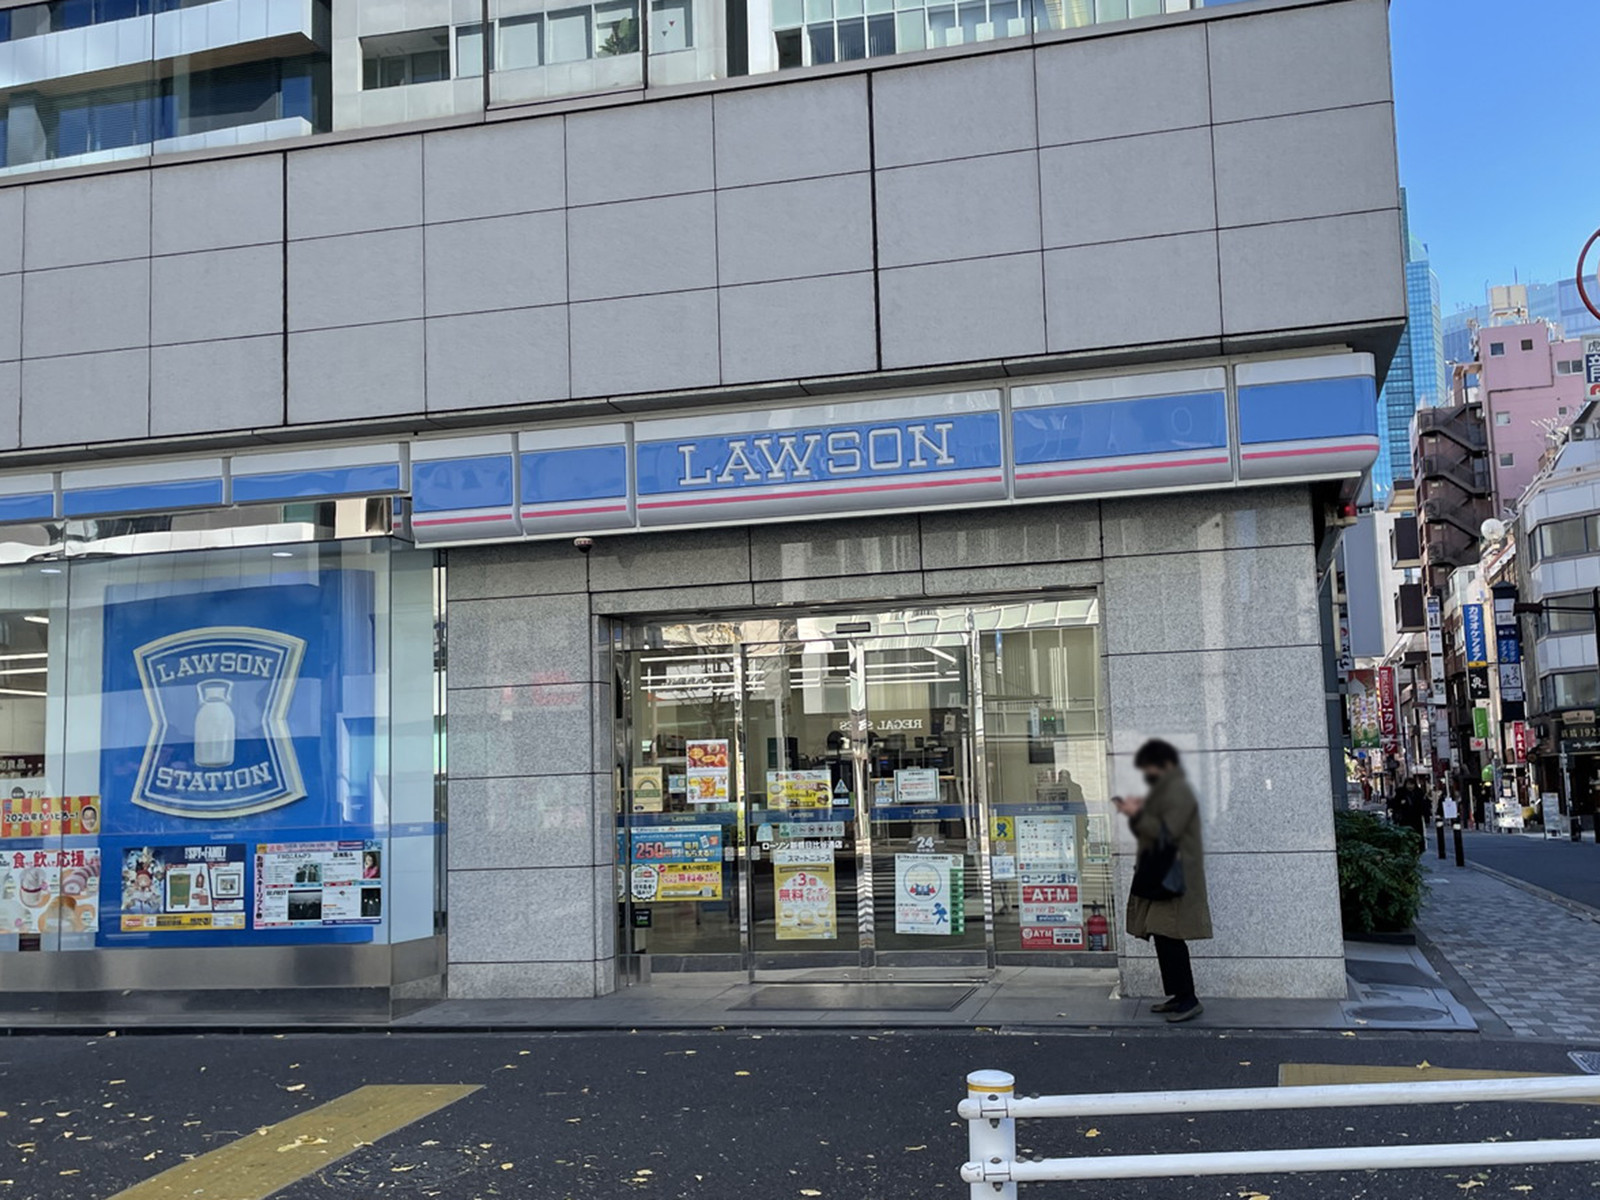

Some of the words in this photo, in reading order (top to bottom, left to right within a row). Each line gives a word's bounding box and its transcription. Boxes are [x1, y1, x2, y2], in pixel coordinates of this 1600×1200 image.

[678, 422, 955, 486] LAWSON
[157, 653, 273, 682] LAWSON
[156, 762, 272, 791] STATION
[916, 836, 934, 849] 24
[1021, 874, 1076, 883] ローソン銀行
[1032, 888, 1070, 901] ATM
